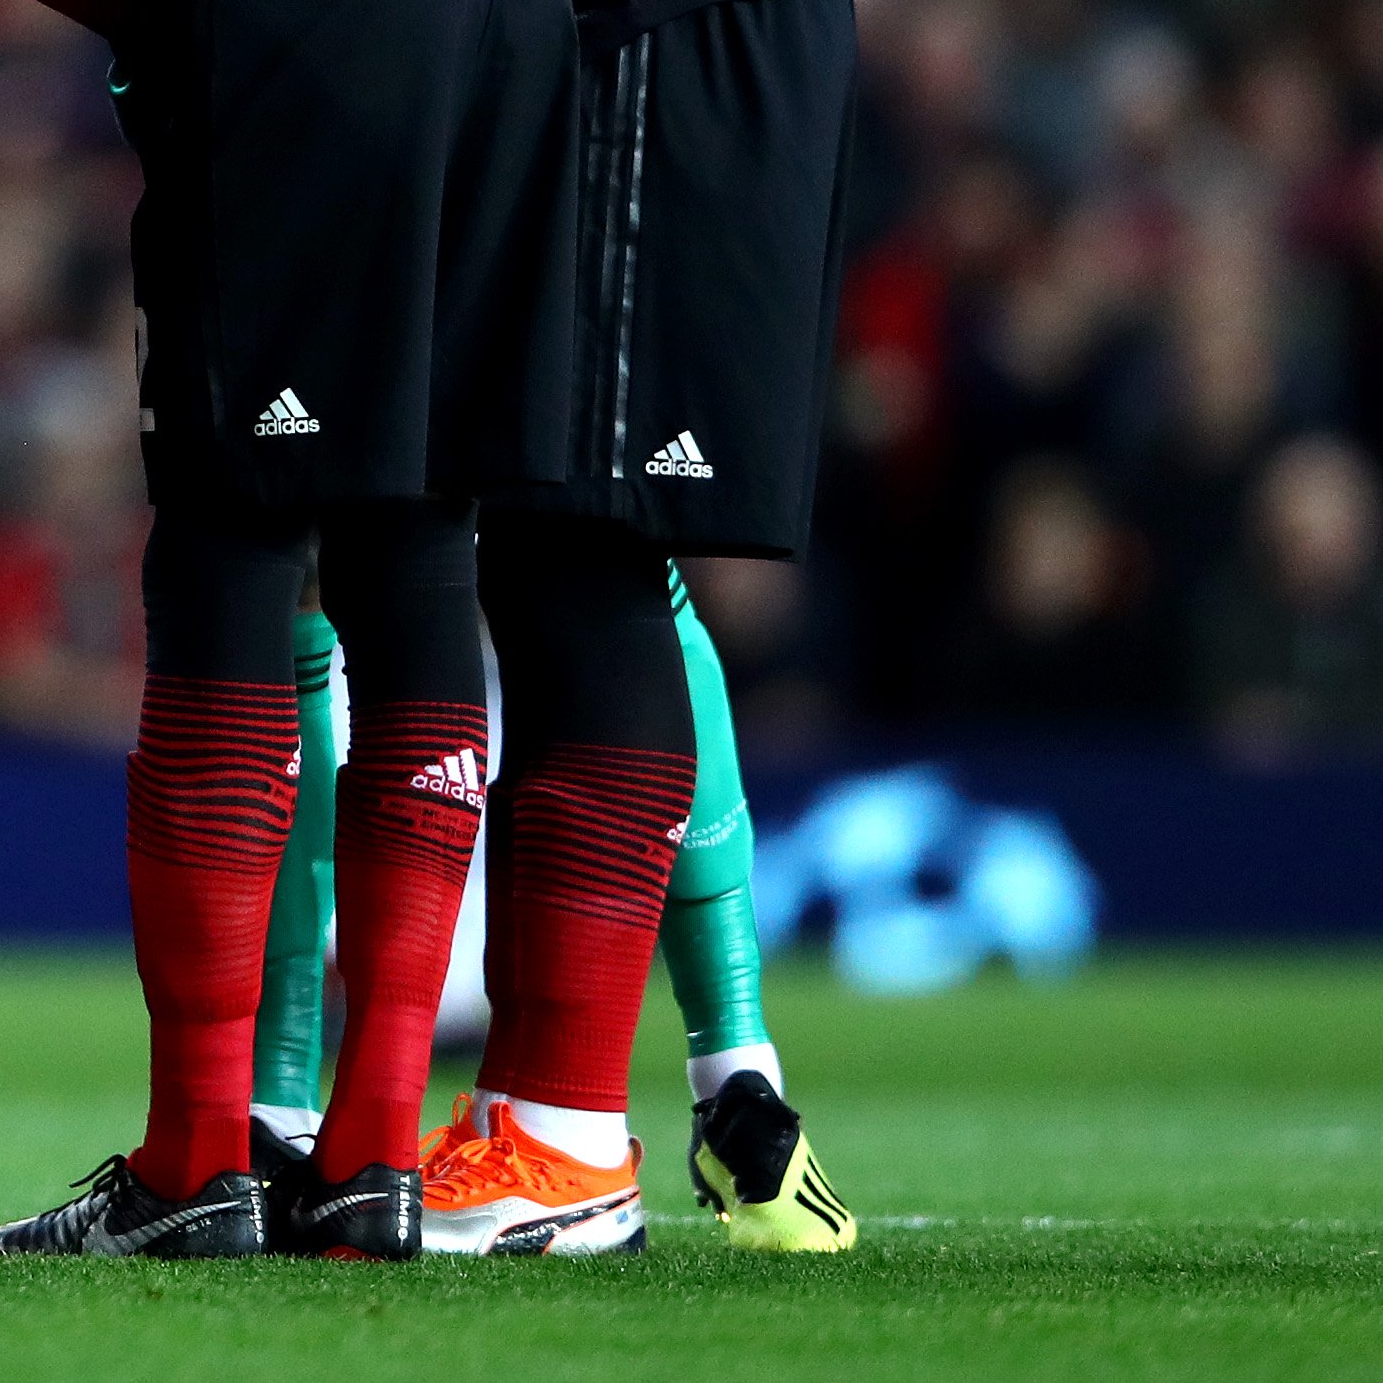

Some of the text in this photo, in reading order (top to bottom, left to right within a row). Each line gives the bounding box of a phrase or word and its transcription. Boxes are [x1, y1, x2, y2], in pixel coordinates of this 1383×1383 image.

[254, 417, 320, 436] adidas
[645, 458, 714, 478] adidas
[410, 774, 485, 810] adidas
[397, 1175, 411, 1241] TIEMPO
